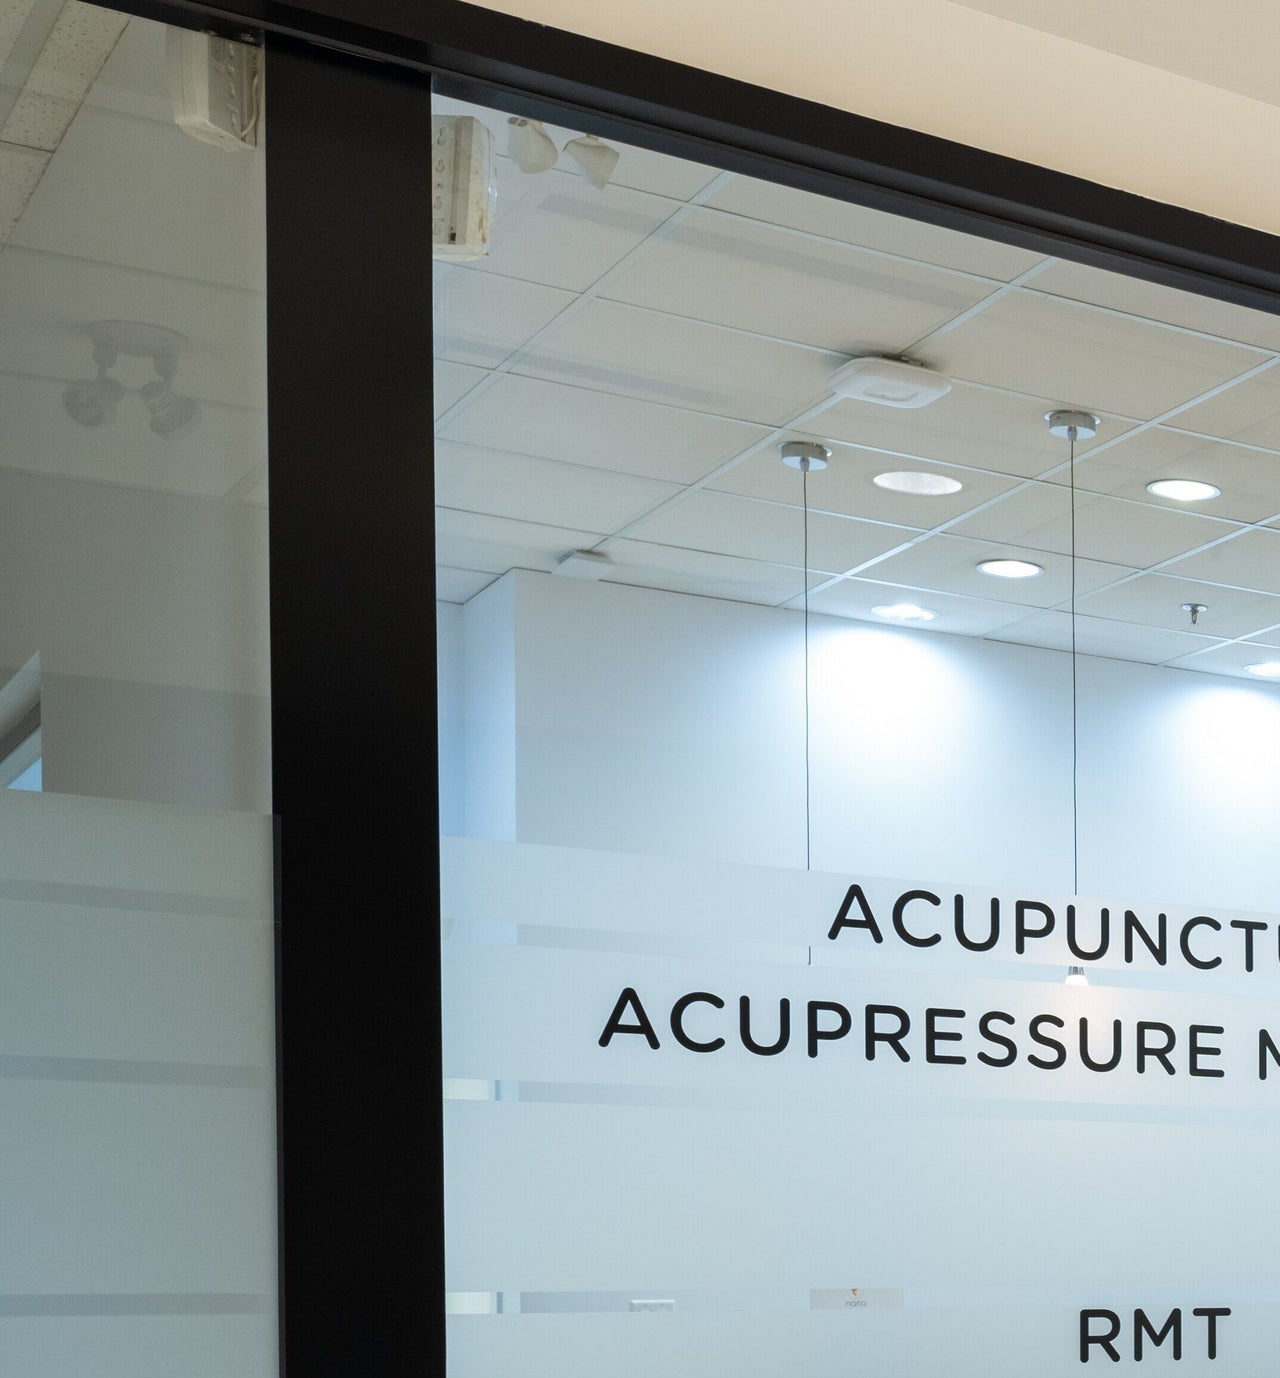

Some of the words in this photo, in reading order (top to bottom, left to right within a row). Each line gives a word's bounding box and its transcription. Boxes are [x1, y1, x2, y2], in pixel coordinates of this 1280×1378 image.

[599, 987, 1225, 1078] ACUPRESSURE
[845, 1300, 868, 1308] nano
[1080, 1307, 1232, 1364] RMT
